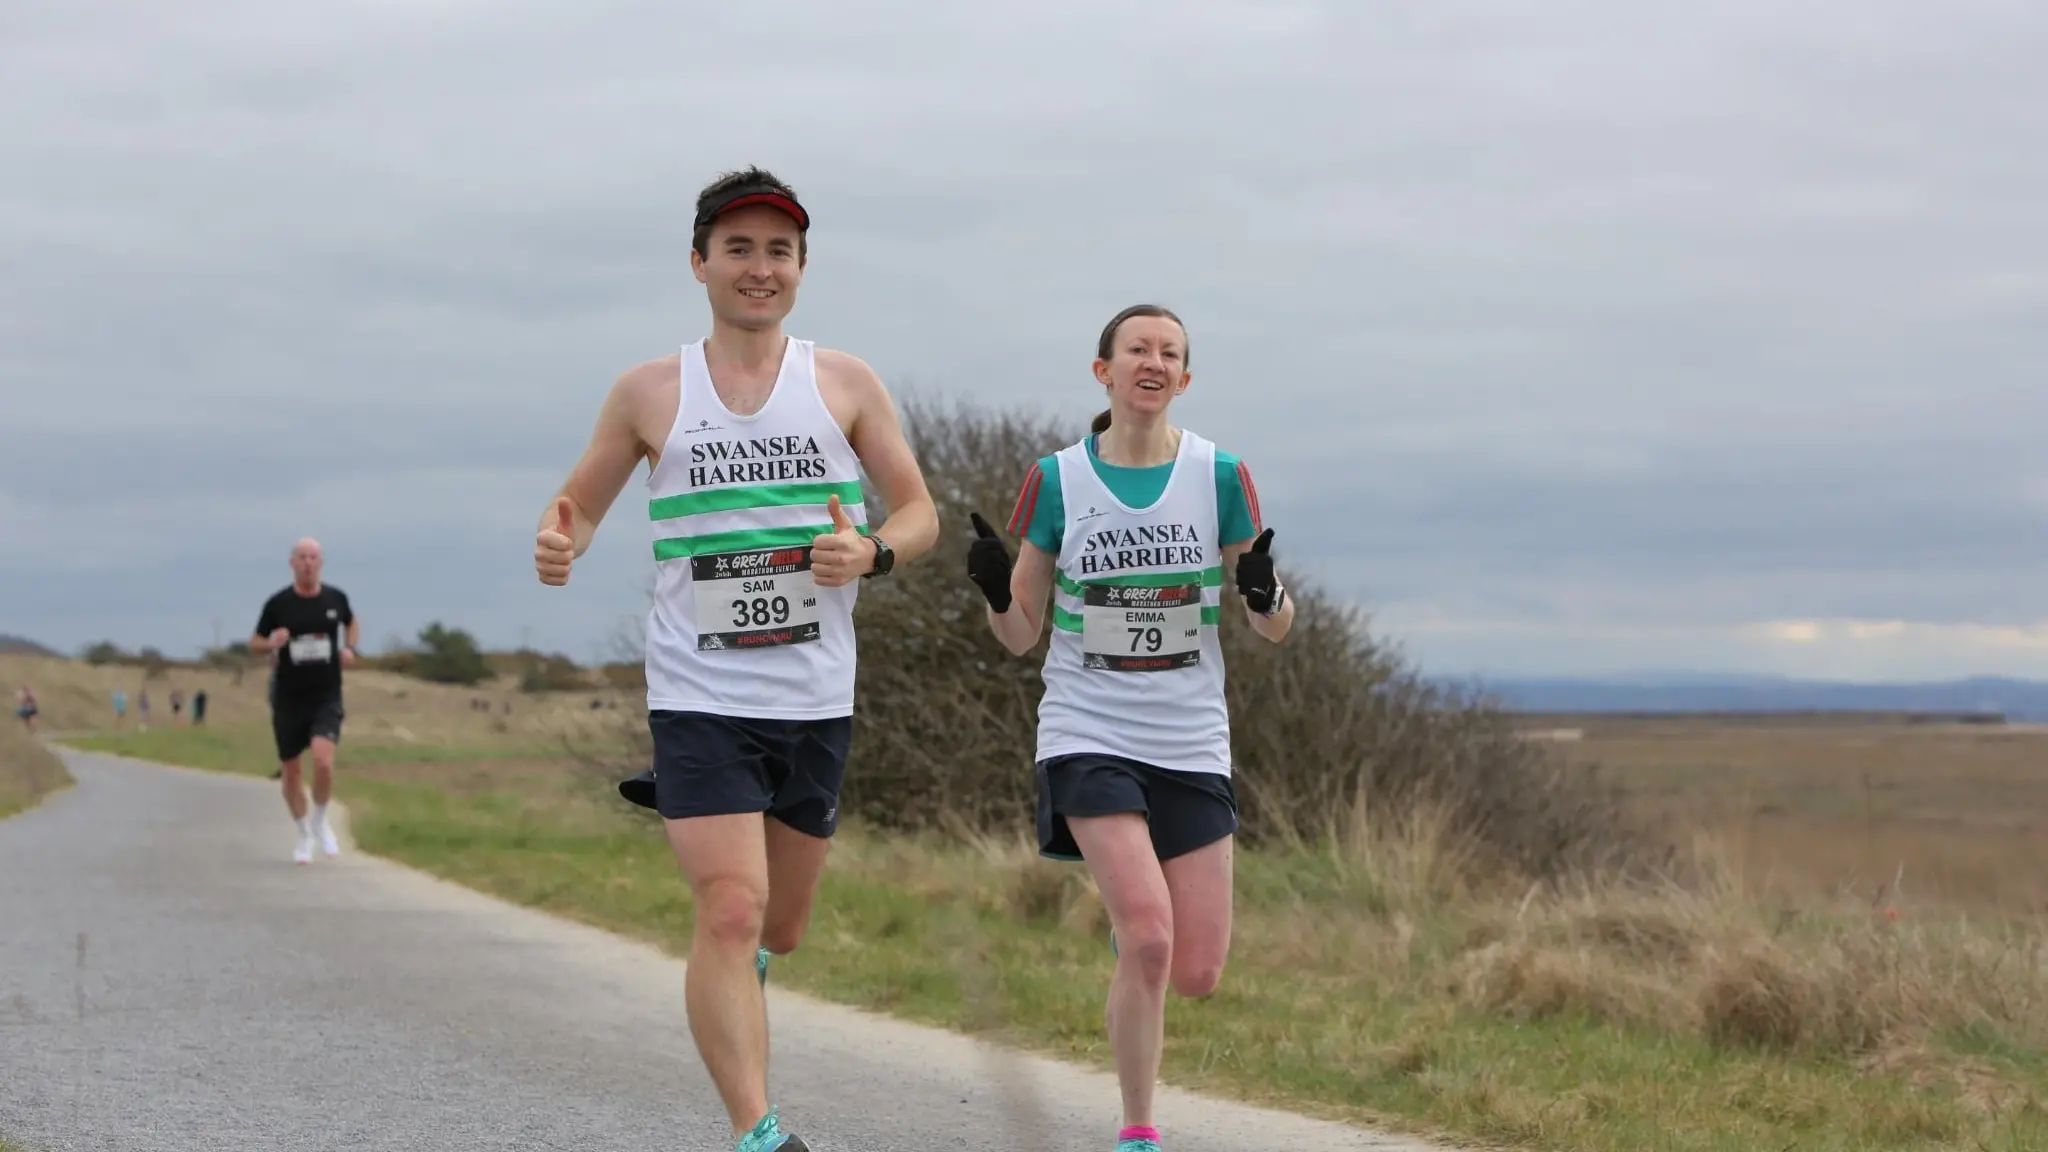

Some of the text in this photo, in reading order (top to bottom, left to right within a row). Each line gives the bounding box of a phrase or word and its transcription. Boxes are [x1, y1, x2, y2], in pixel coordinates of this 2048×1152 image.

[691, 436, 820, 463] SWANSEA
[689, 458, 826, 487] HARRIERS
[1085, 524, 1199, 552] SWANSEA
[741, 566, 774, 577] MARATHON
[1080, 546, 1203, 574] HARRIERS
[742, 579, 775, 593] SAM
[731, 595, 816, 627] 389 HM
[1125, 611, 1166, 623] EMMA
[1127, 627, 1198, 652] 79 HM
